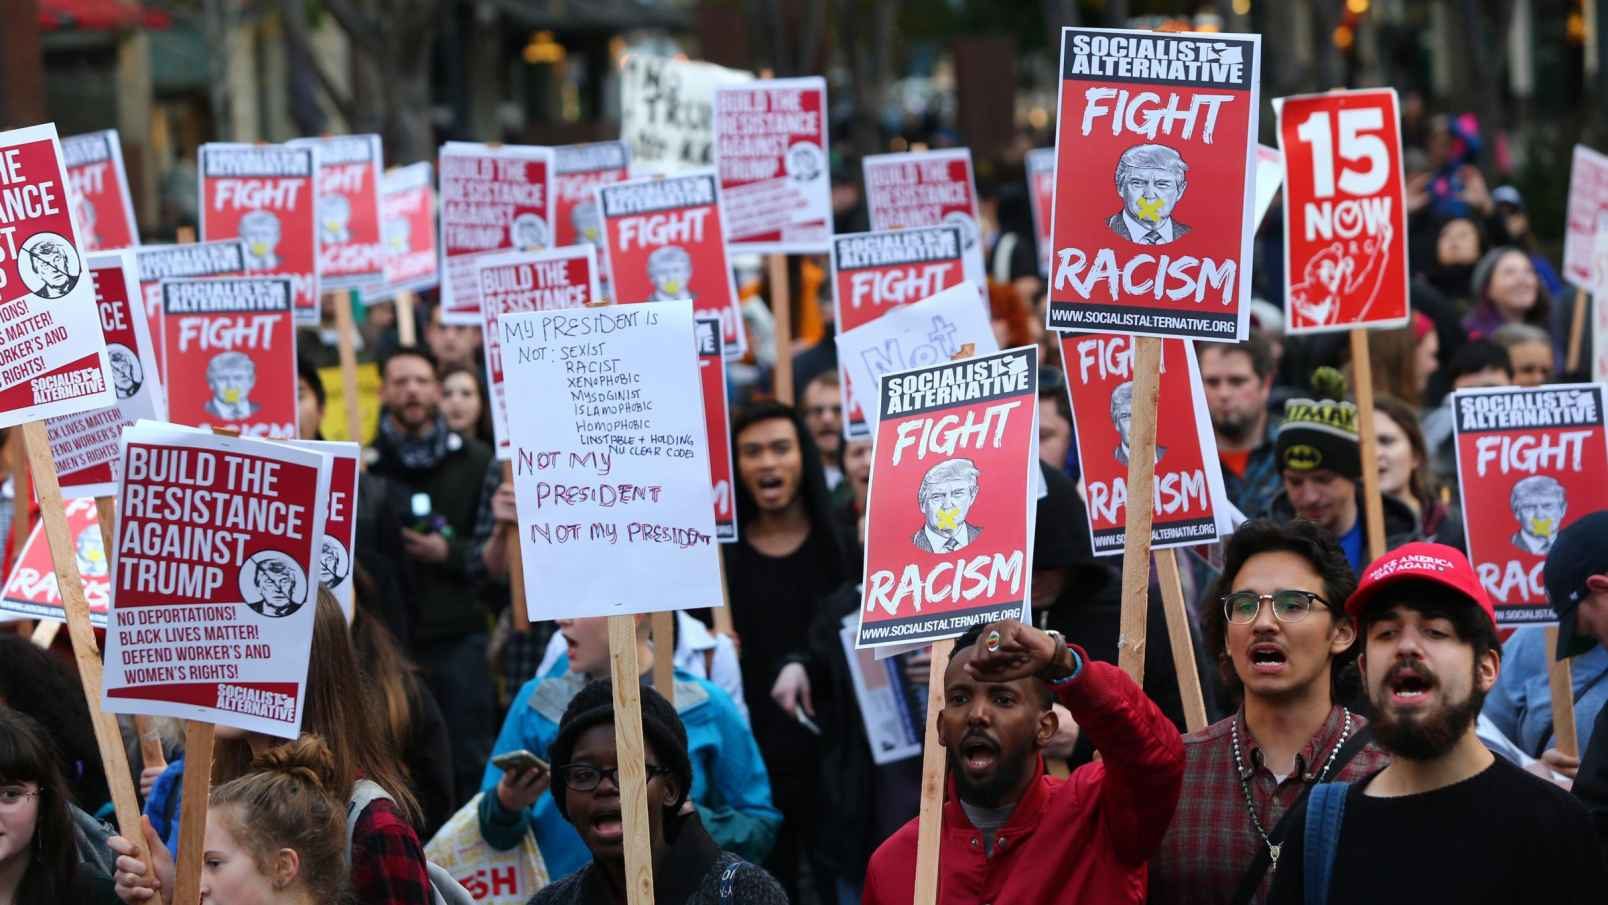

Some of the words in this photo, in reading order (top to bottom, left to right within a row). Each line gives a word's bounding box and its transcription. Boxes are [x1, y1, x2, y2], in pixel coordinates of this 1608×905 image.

[1073, 34, 1208, 62] SOCIALIST
[1071, 54, 1243, 84] ALTERNATIVE
[1081, 86, 1236, 145] FIGHT
[1297, 107, 1390, 198] 15
[214, 178, 304, 211] FIGHT
[617, 207, 710, 252] FIGHT
[1304, 197, 1393, 240] NOW
[850, 262, 954, 308] FIGHT
[1054, 247, 1237, 306] RACISM
[5, 311, 54, 341] MATTER!
[44, 326, 68, 347] AND
[177, 314, 282, 352] FIGHT
[543, 311, 638, 342] PRESIDENT
[1051, 309, 1236, 334] WWW.SOCIALISTALTERNATIVE.ORG
[2, 356, 46, 386] RIGHTS!
[31, 371, 88, 391] SOCIALIST
[566, 358, 621, 374] RACIST
[888, 360, 1002, 398] SOCIALIST
[32, 381, 105, 405] ALTERNATIVE
[887, 371, 1029, 416] ALTERNATIVE
[1461, 391, 1570, 414] SOCIALIST
[1462, 405, 1598, 430] ALTERNATIVE
[893, 400, 1022, 466] FIGHT
[518, 447, 561, 476] NOT
[1476, 430, 1593, 478] FIGHT
[127, 447, 217, 487] BUILD
[224, 455, 282, 498] THE
[536, 482, 662, 509] PRESIDENT
[1088, 468, 1208, 525] RAISM
[124, 483, 306, 540] RESISTANCE
[121, 520, 251, 567] AGAINST
[531, 522, 581, 545] NOT
[626, 522, 712, 549] PRESIDENT
[1400, 554, 1454, 569] AMERICA
[118, 557, 224, 600] TRUMP
[866, 549, 1024, 616] RACISM
[117, 612, 138, 627] NO
[139, 606, 237, 625] DEPORTATIONS!
[862, 607, 1021, 641] WWW.SOCIALISTALTERNATIVE.ORG
[120, 629, 162, 647] BLACK
[165, 626, 201, 642] LIVES
[204, 624, 260, 641] MATTER!
[122, 647, 173, 666] DEFEND
[175, 644, 241, 663] WORKER'S
[244, 644, 272, 660] AND
[123, 666, 186, 685] WOMEN'S
[190, 664, 239, 681] RIGHTS!
[216, 696, 296, 723] ALTERNATIVE
[217, 683, 285, 706] SOCIALIST
